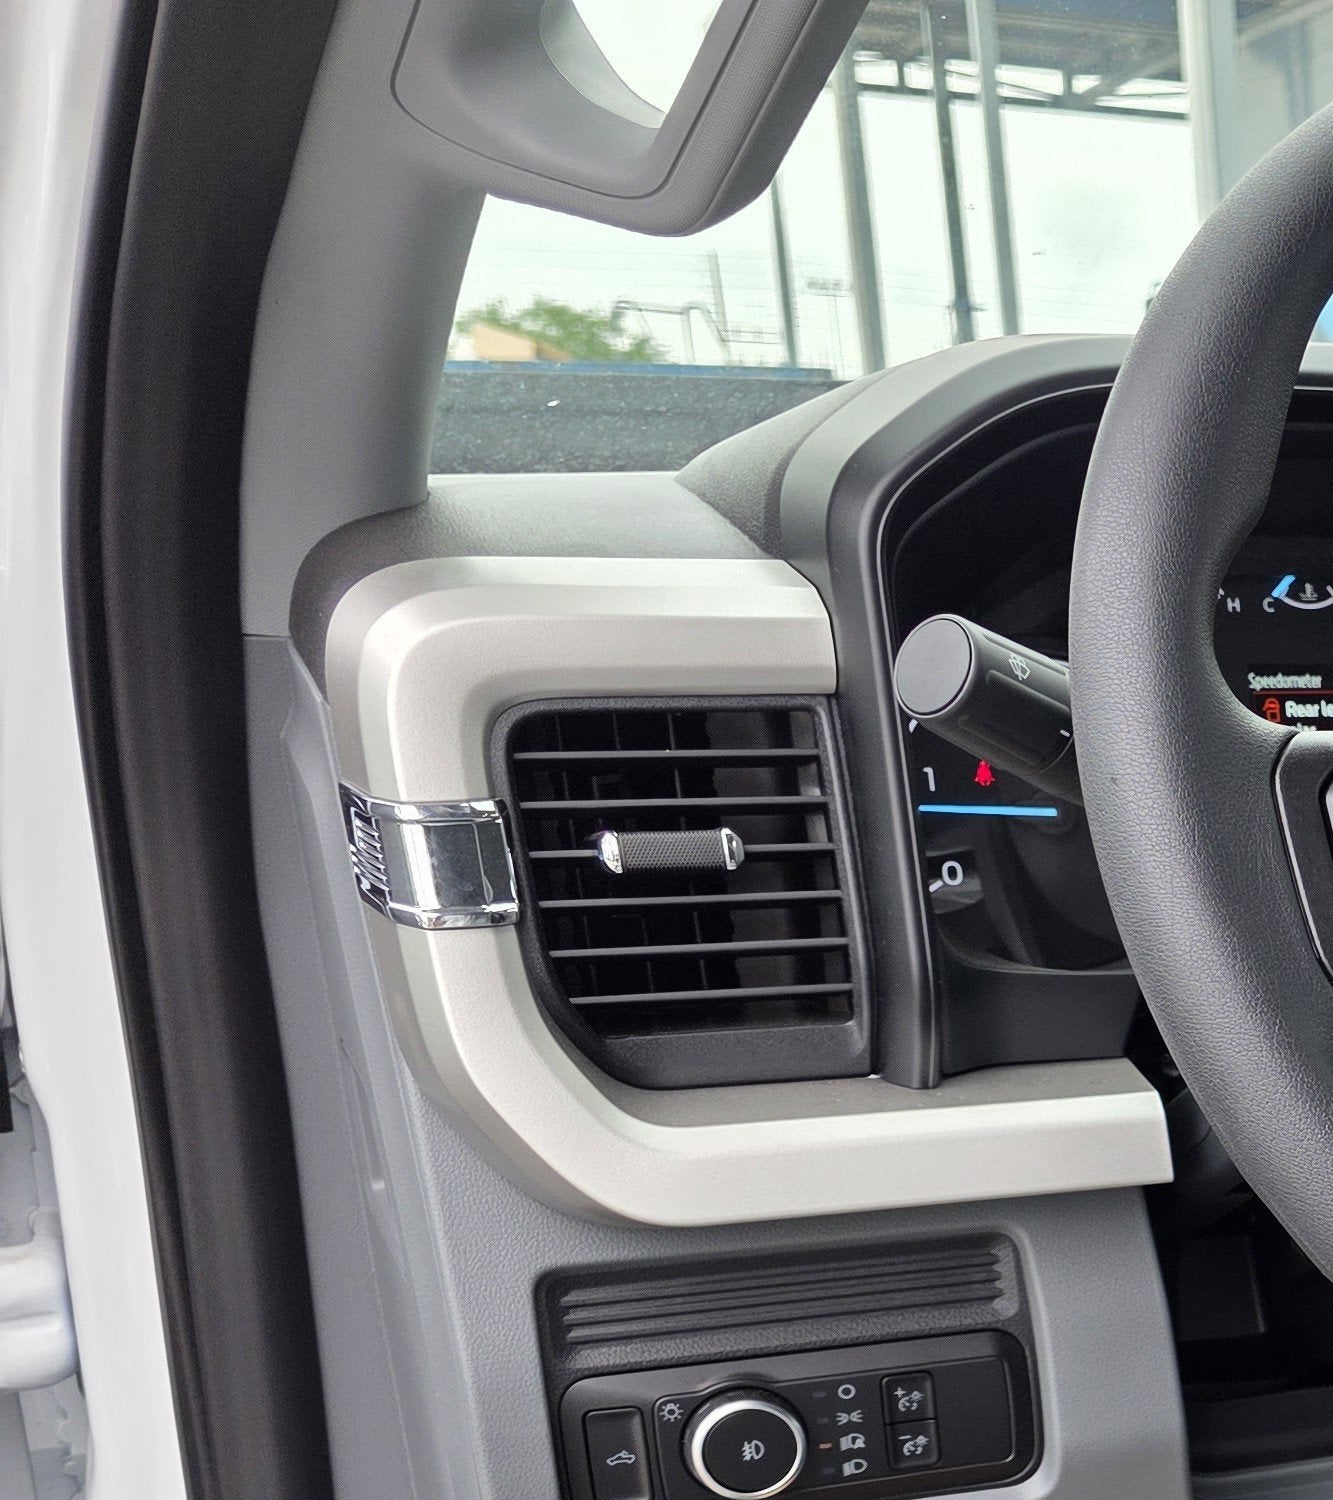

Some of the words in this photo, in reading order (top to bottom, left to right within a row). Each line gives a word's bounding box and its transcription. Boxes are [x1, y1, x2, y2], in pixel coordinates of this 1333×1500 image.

[1226, 598, 1241, 613] H
[1262, 597, 1276, 613] C
[1248, 672, 1322, 691] Speedometer
[1285, 701, 1320, 718] Rear
[922, 766, 936, 792] 1
[941, 860, 964, 886] 0
